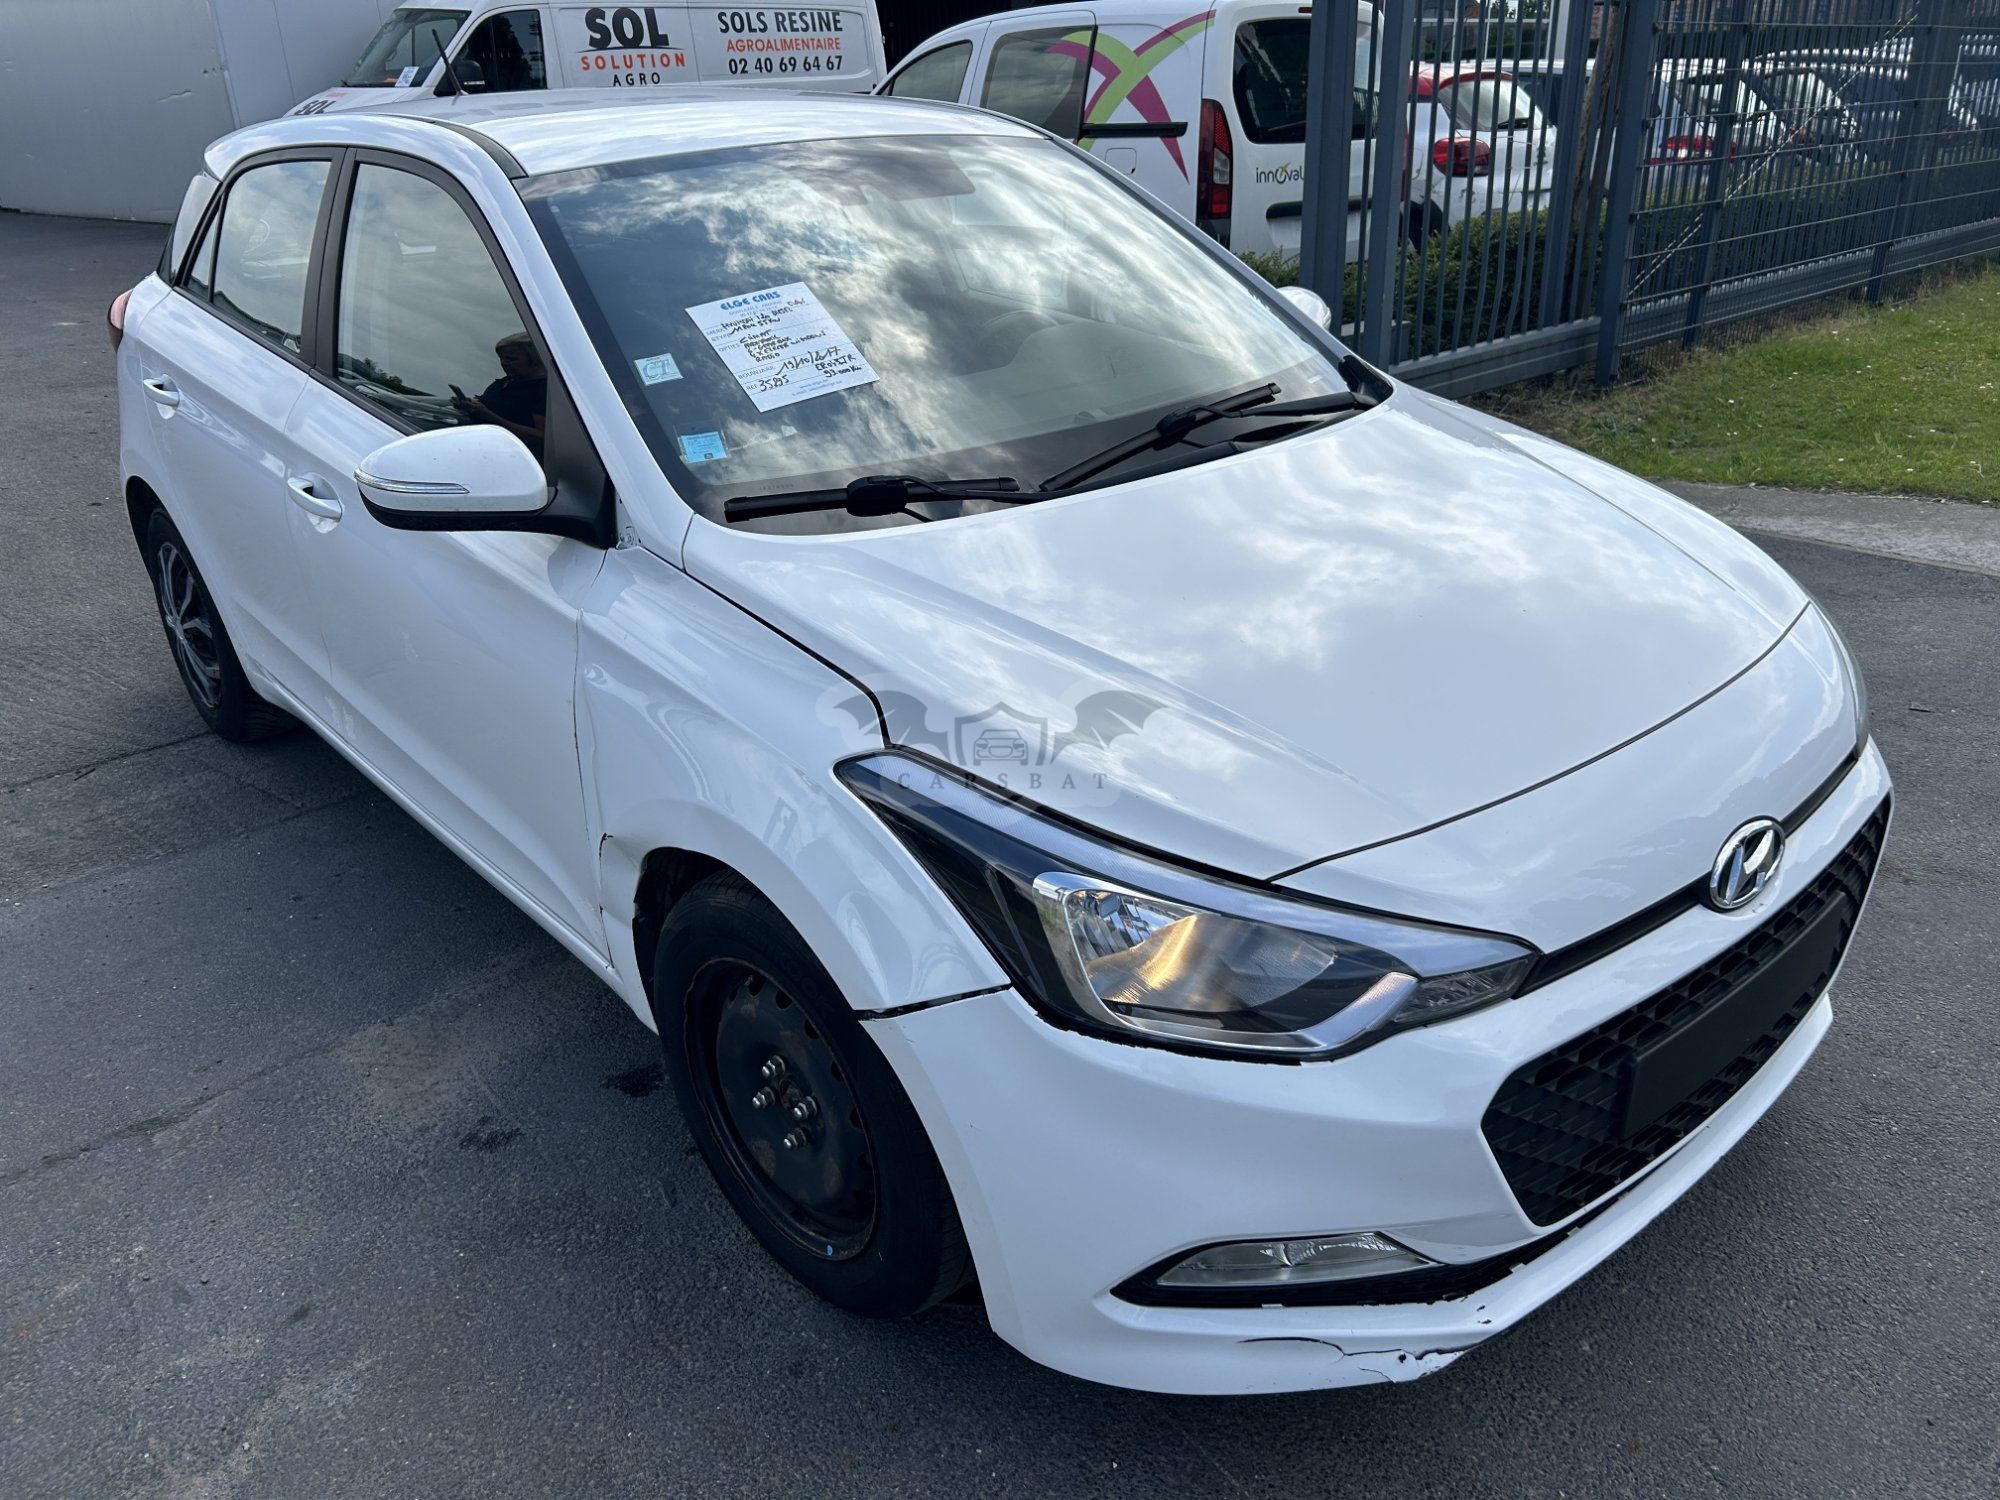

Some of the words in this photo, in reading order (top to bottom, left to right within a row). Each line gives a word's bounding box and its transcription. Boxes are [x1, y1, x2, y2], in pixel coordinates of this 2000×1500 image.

[585, 7, 669, 48] SOL
[717, 12, 768, 33] SOLS
[774, 11, 843, 32] RESINE
[727, 37, 841, 52] AGROALIMENTAIRE
[581, 53, 686, 71] SOLUTION
[729, 58, 748, 74] 02
[755, 57, 773, 73] 40
[779, 56, 797, 72] 69
[803, 56, 821, 71] 64
[826, 55, 843, 70] 67
[613, 72, 661, 87] AGRO
[294, 100, 337, 115] SOL
[720, 298, 750, 310] ELGE
[752, 291, 781, 302] CARS
